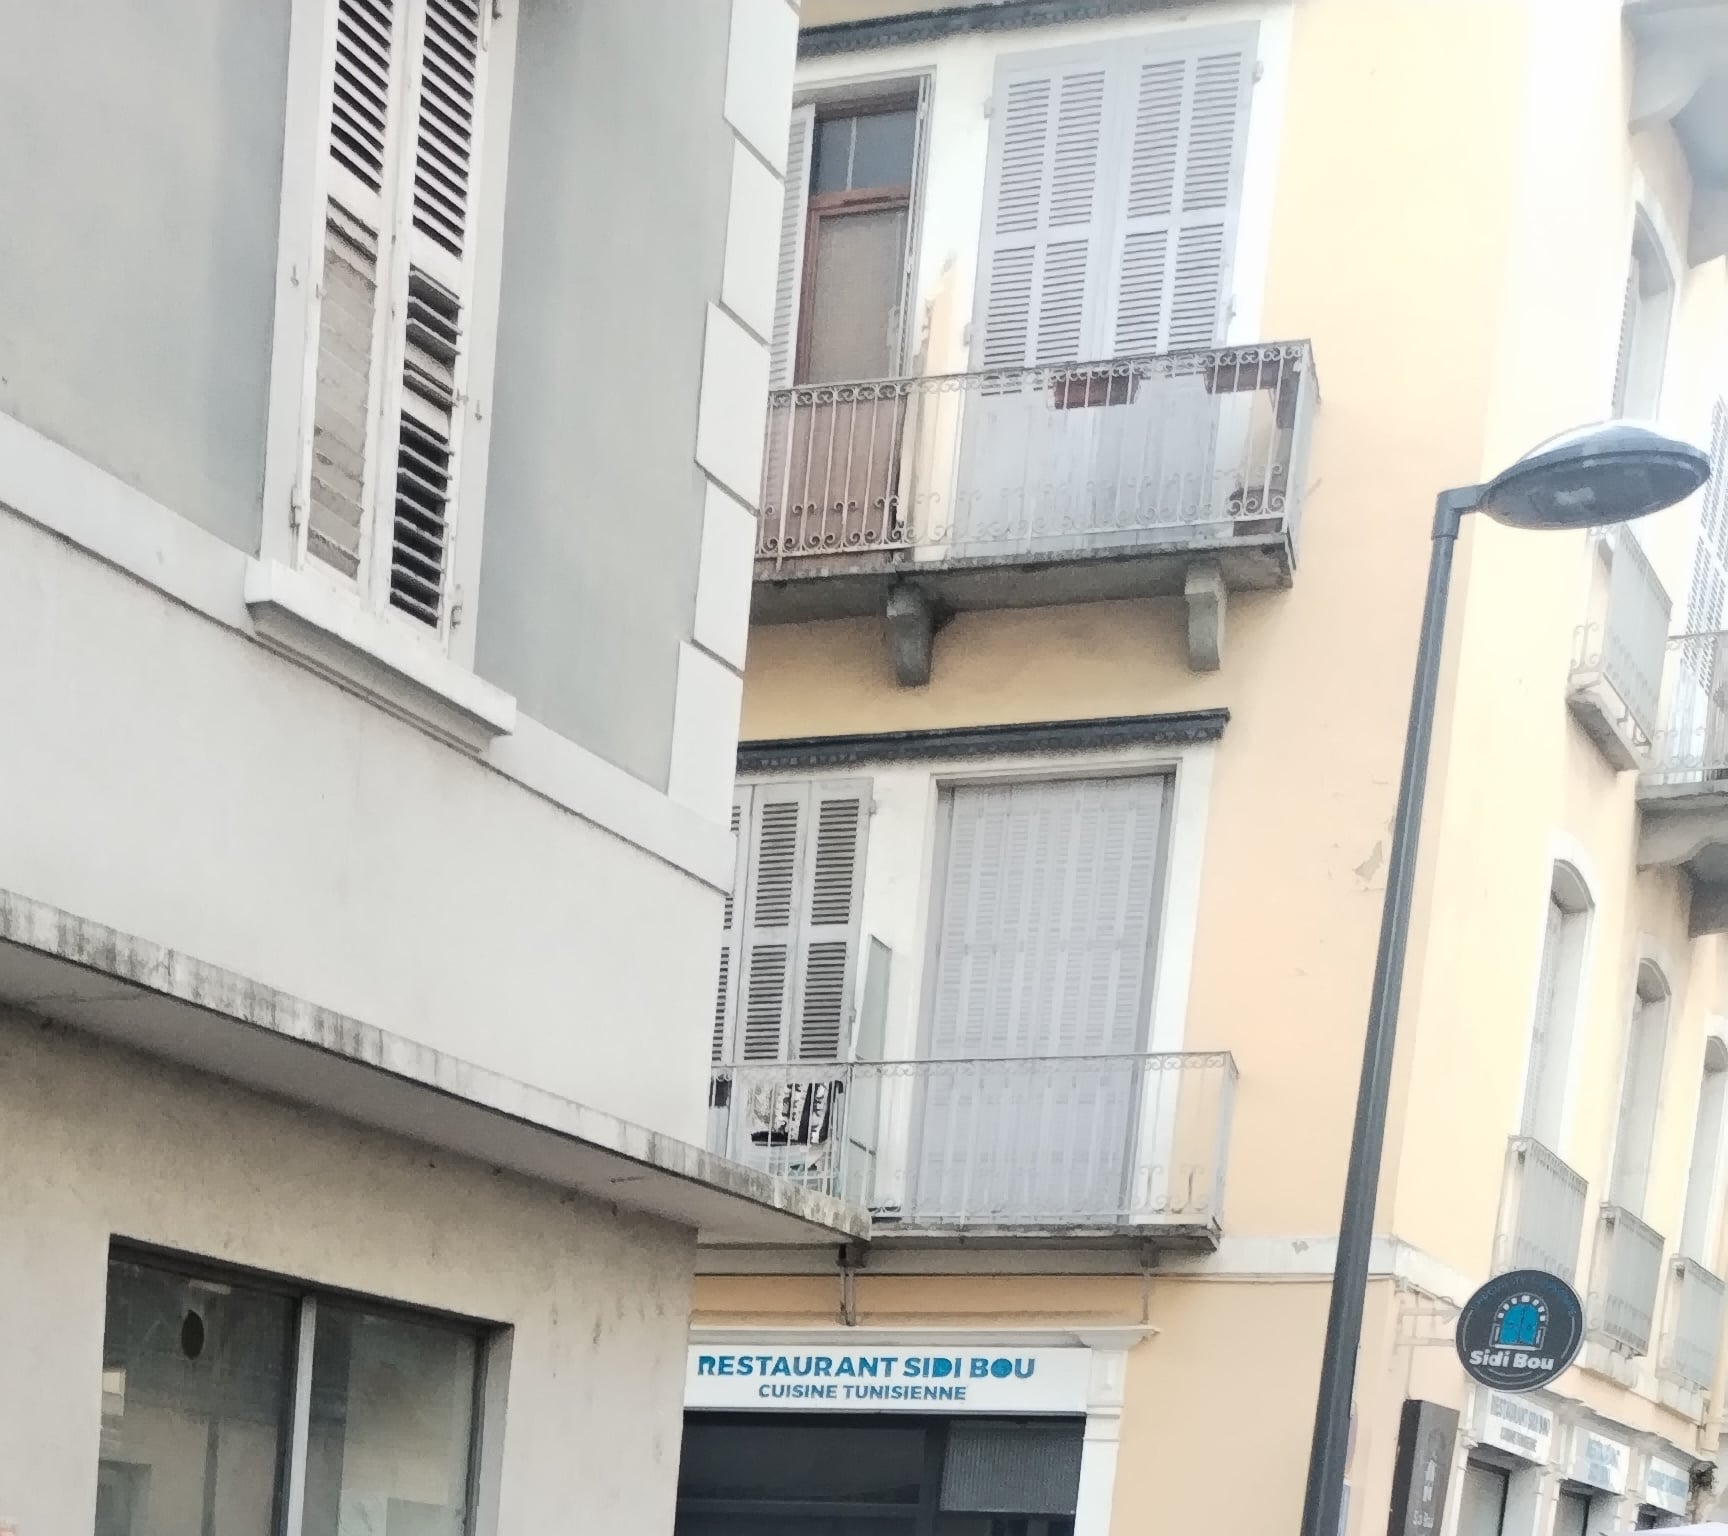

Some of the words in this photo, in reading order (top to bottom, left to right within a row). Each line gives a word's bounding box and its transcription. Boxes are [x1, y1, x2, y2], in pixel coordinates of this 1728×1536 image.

[697, 1355, 898, 1378] RESTAURANT
[902, 1357, 962, 1379] SIDI
[969, 1358, 1035, 1379] BOU
[1469, 1349, 1511, 1367] Sidi
[1513, 1353, 1555, 1370] Bou
[758, 1384, 838, 1399] CUISINE
[843, 1385, 967, 1400] TUNISIENNE
